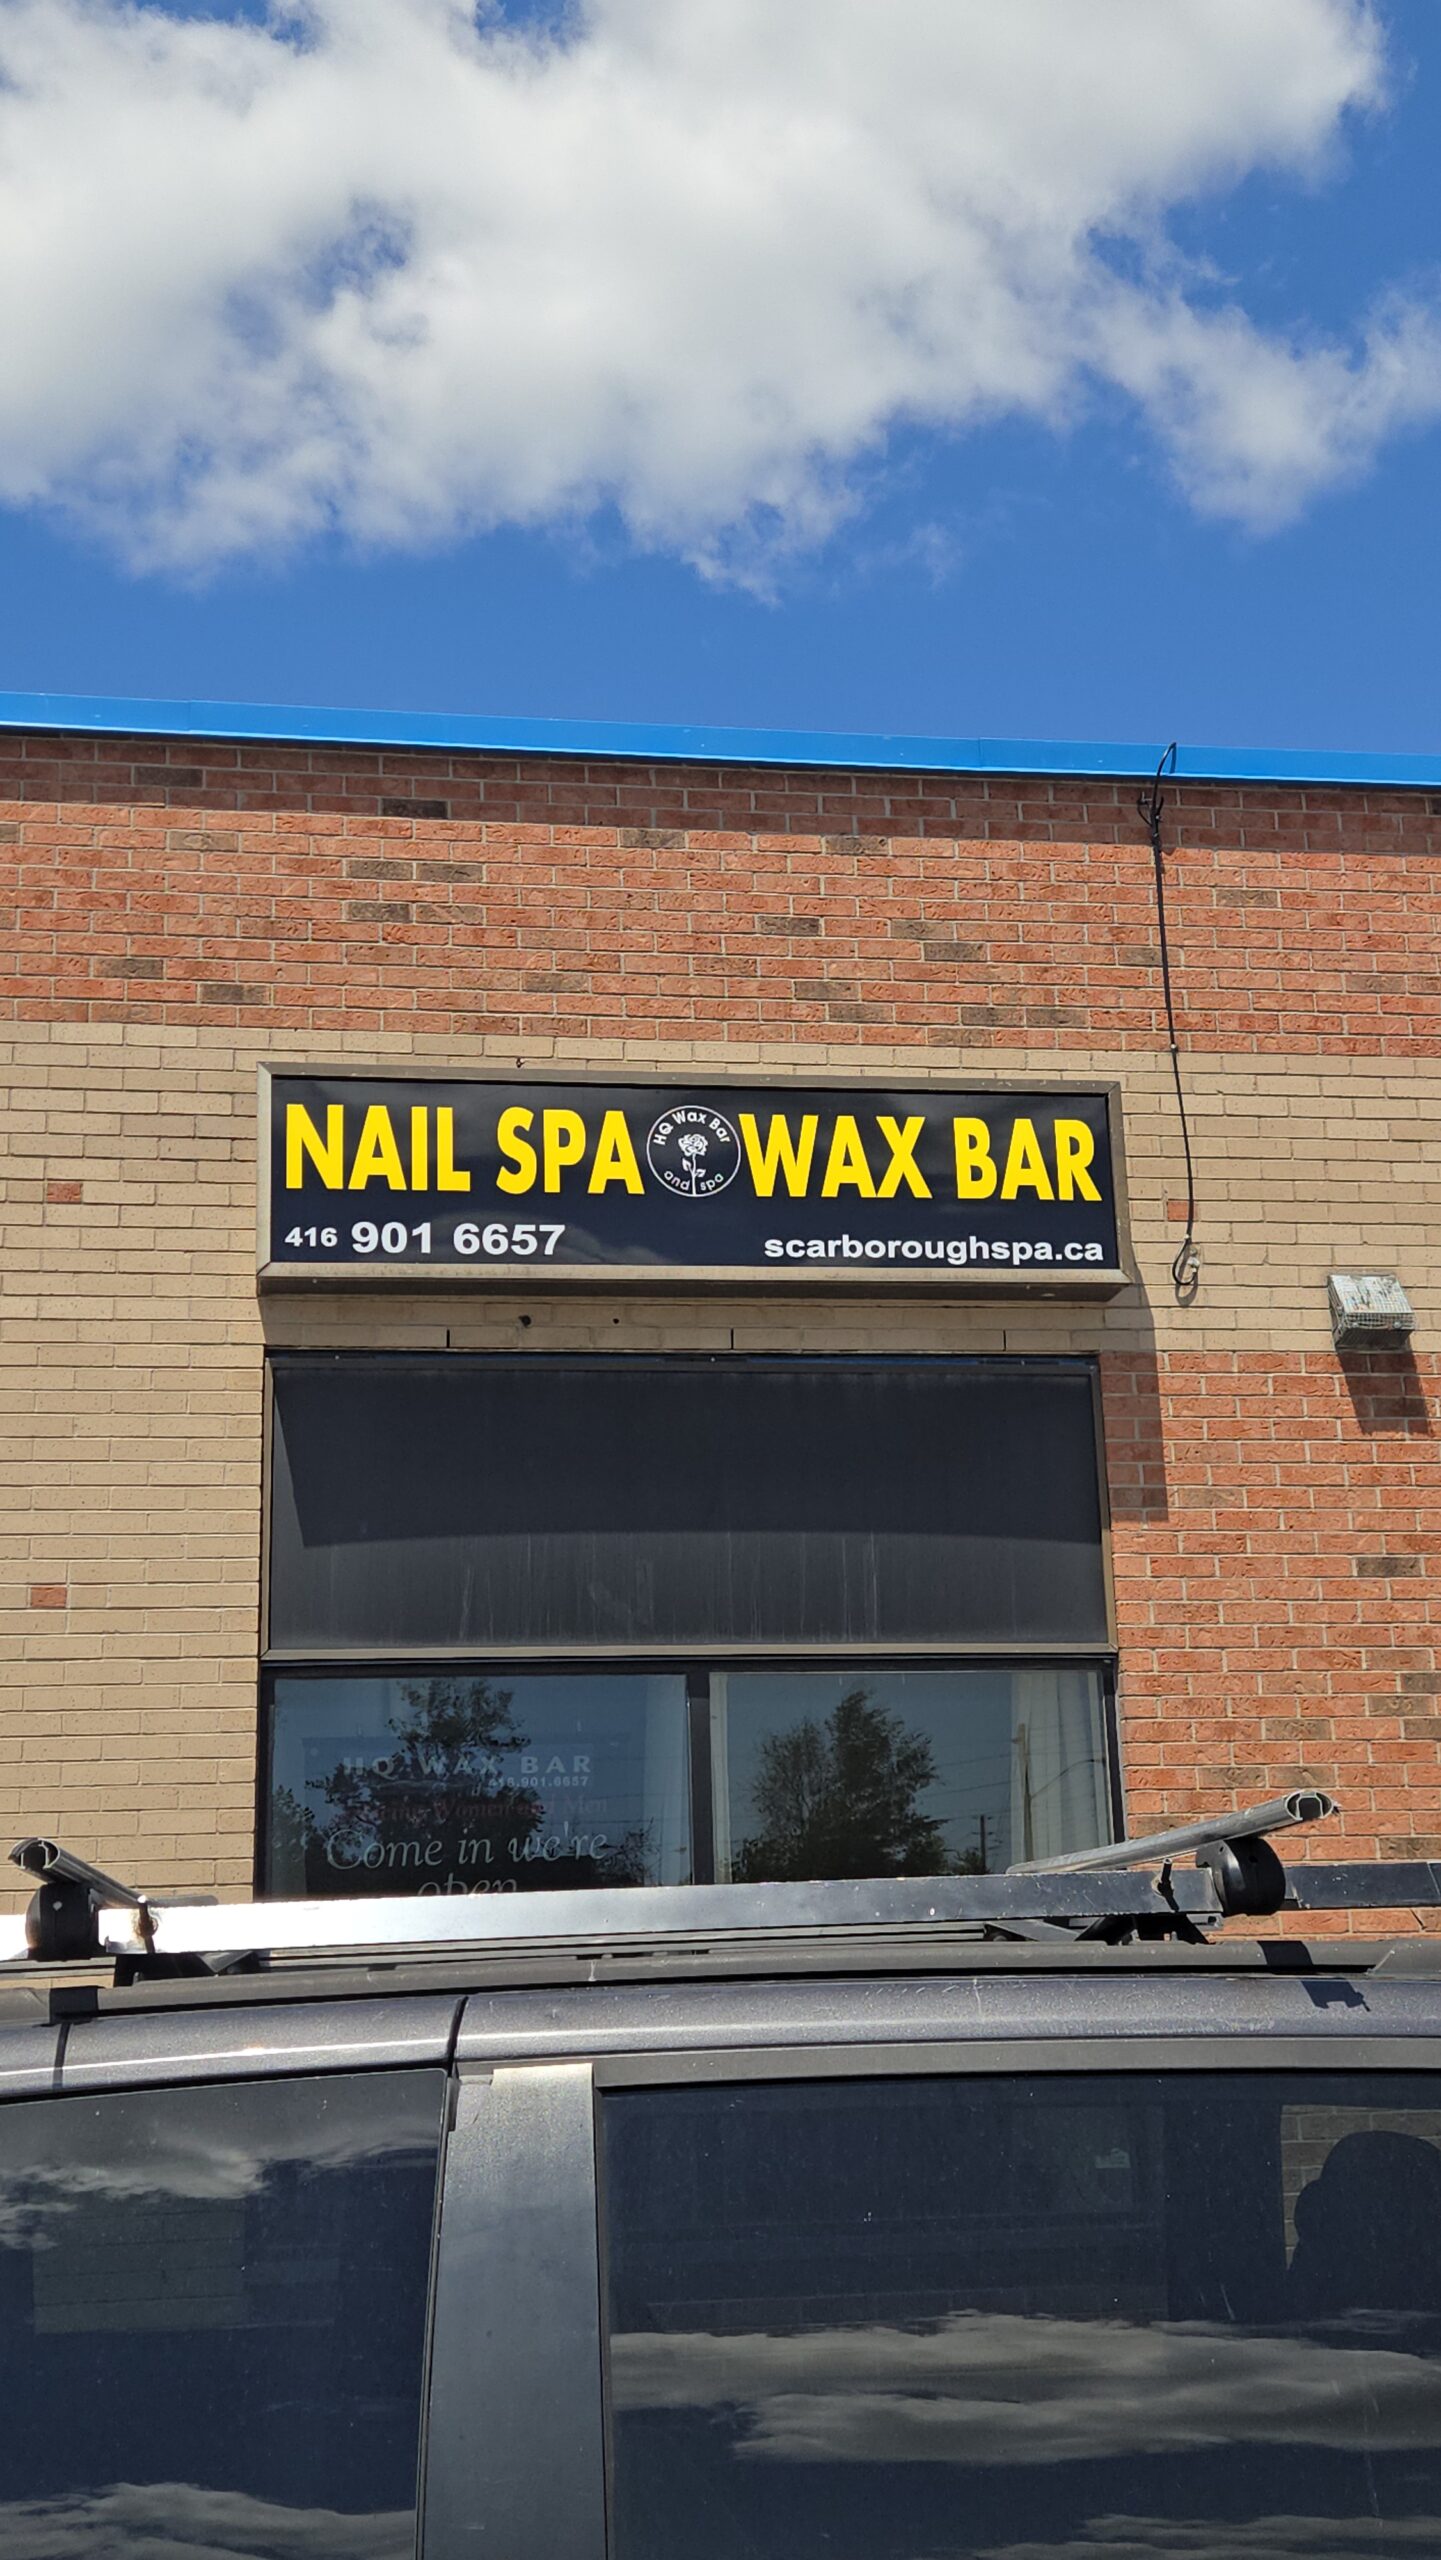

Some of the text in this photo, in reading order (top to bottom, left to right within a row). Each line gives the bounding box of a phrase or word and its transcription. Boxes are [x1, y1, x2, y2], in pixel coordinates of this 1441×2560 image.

[653, 1110, 731, 1146] HQ Wax Bar
[286, 1104, 645, 1195] NAIL SPA
[738, 1113, 1102, 1202] WAX BAR
[663, 1170, 724, 1191] and spa
[284, 1221, 566, 1257] 416 901 6657
[763, 1232, 1104, 1266] scarboroughspa.ca
[416, 1755, 498, 1775] WAX
[520, 1756, 591, 1774] BAR
[327, 1820, 609, 1870] Come in we're
